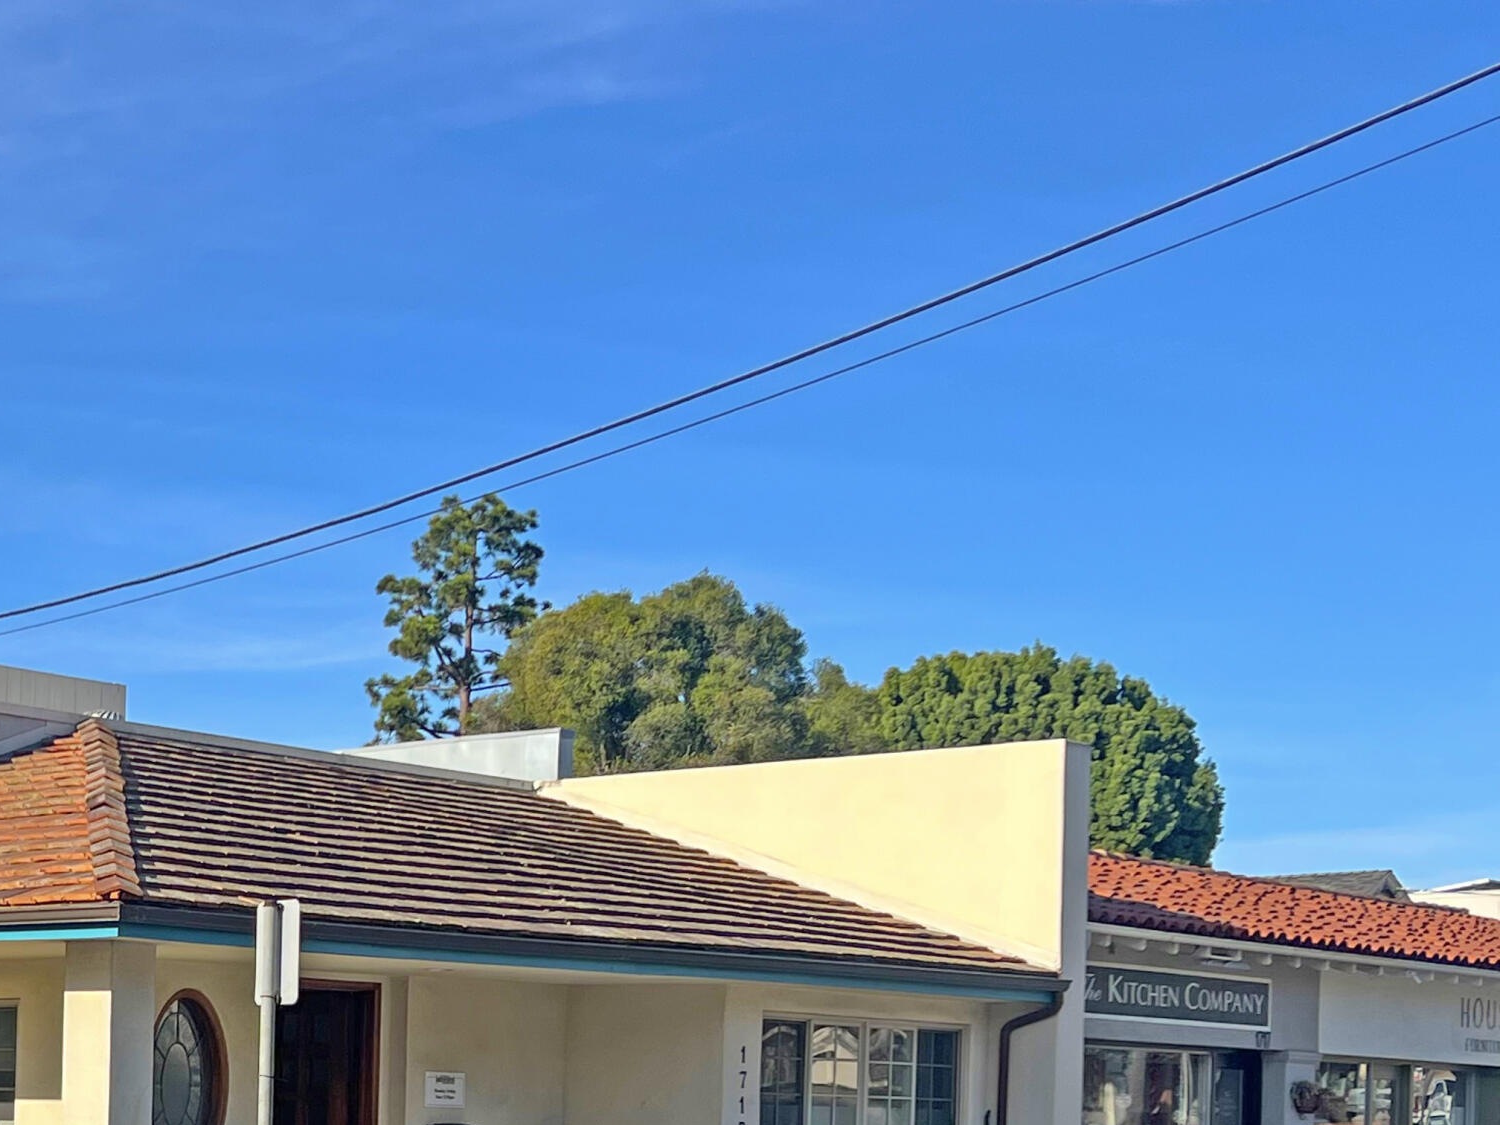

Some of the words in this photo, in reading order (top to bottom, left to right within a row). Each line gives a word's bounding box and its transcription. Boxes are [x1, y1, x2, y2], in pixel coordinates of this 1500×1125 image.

[1108, 974, 1180, 1008] KITCHEN
[1184, 982, 1264, 1015] COMPANY
[1461, 997, 1500, 1030] HOU
